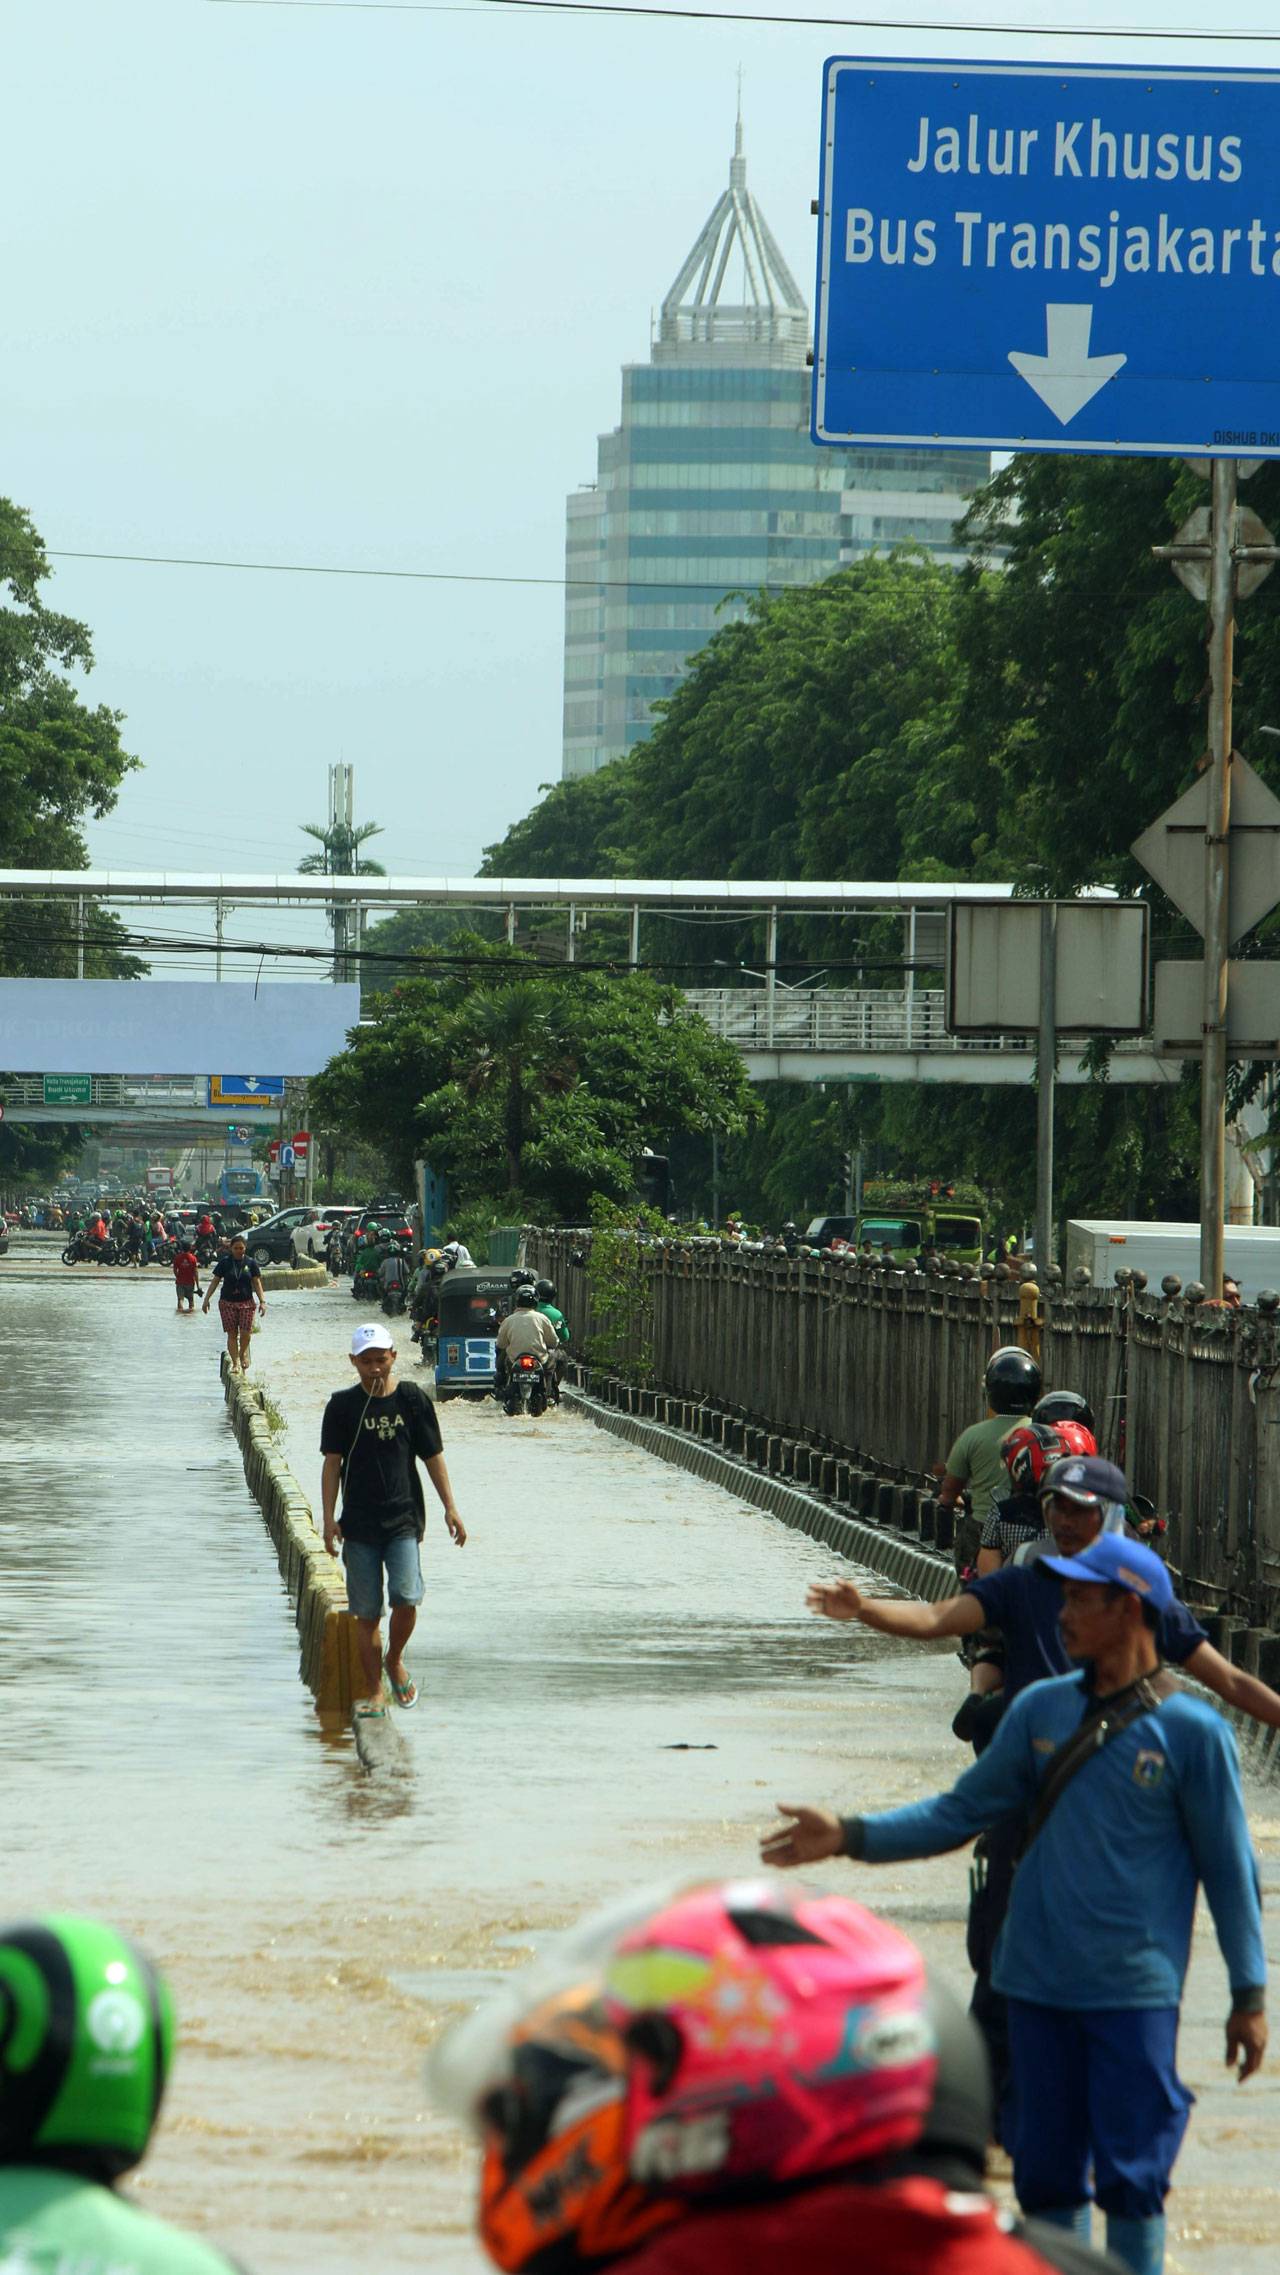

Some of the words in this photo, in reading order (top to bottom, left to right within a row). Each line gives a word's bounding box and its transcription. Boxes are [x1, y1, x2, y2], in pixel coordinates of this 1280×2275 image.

[906, 114, 1038, 175] Jalur
[1054, 118, 1242, 182] Khusus
[845, 208, 937, 266] Bus
[364, 1414, 405, 1430] U.S.A
